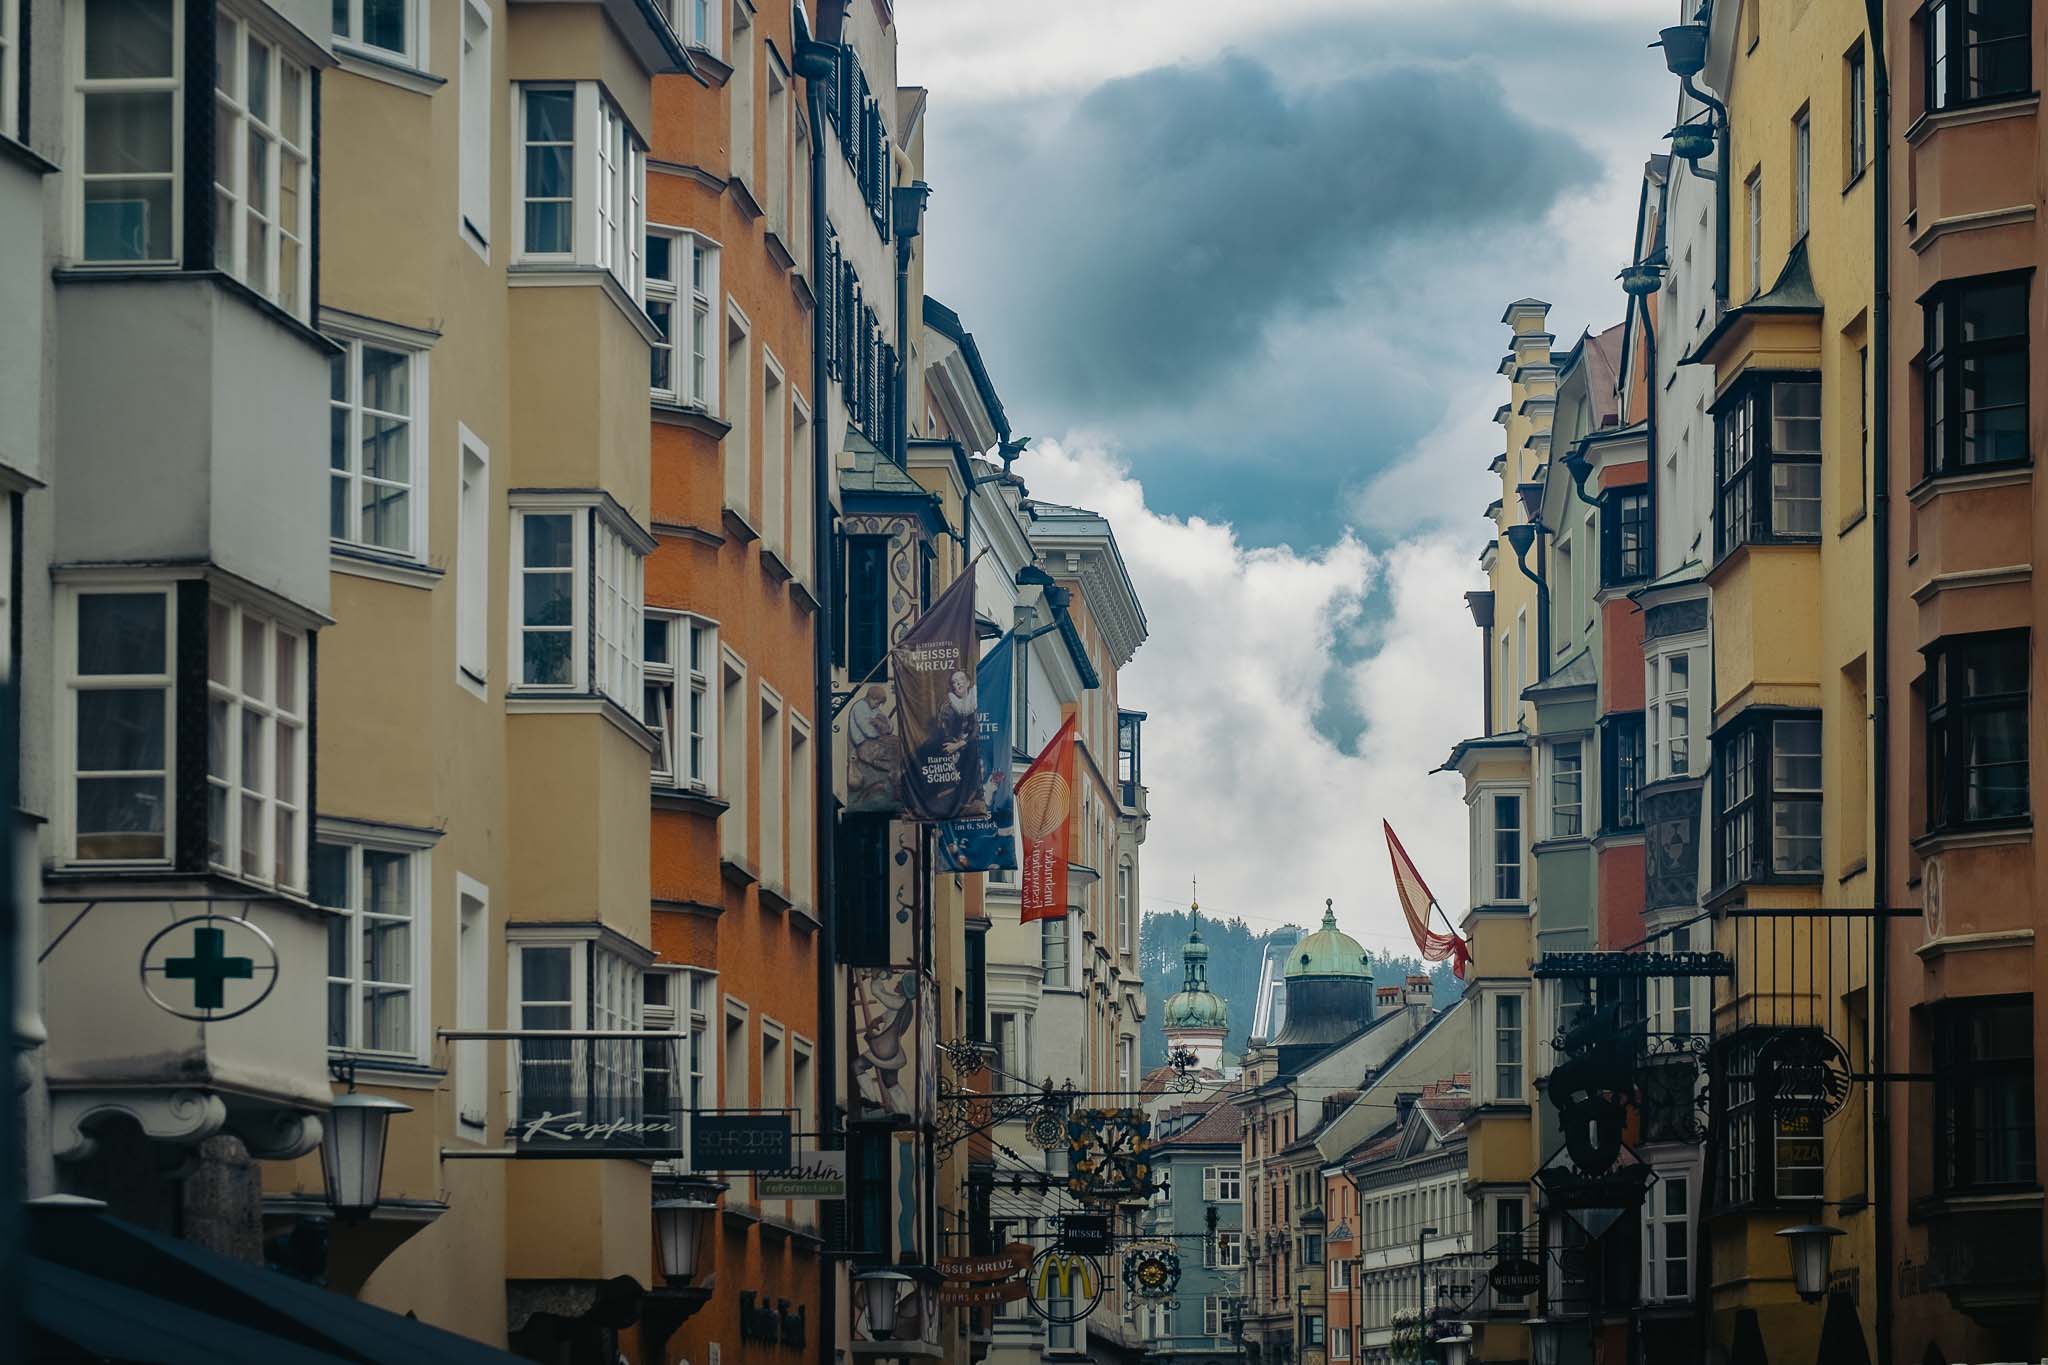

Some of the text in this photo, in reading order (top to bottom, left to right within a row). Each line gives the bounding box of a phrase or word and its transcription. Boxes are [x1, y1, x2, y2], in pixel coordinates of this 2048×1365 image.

[912, 648, 961, 661] WEISSES
[916, 660, 955, 672] KREUZ
[927, 771, 961, 784] SCHOCK
[522, 1111, 677, 1142] Kapferer
[1068, 1229, 1103, 1239] HUSSEL
[977, 1258, 1014, 1273] KREUZ
[1494, 1273, 1542, 1287] WEINHAUS
